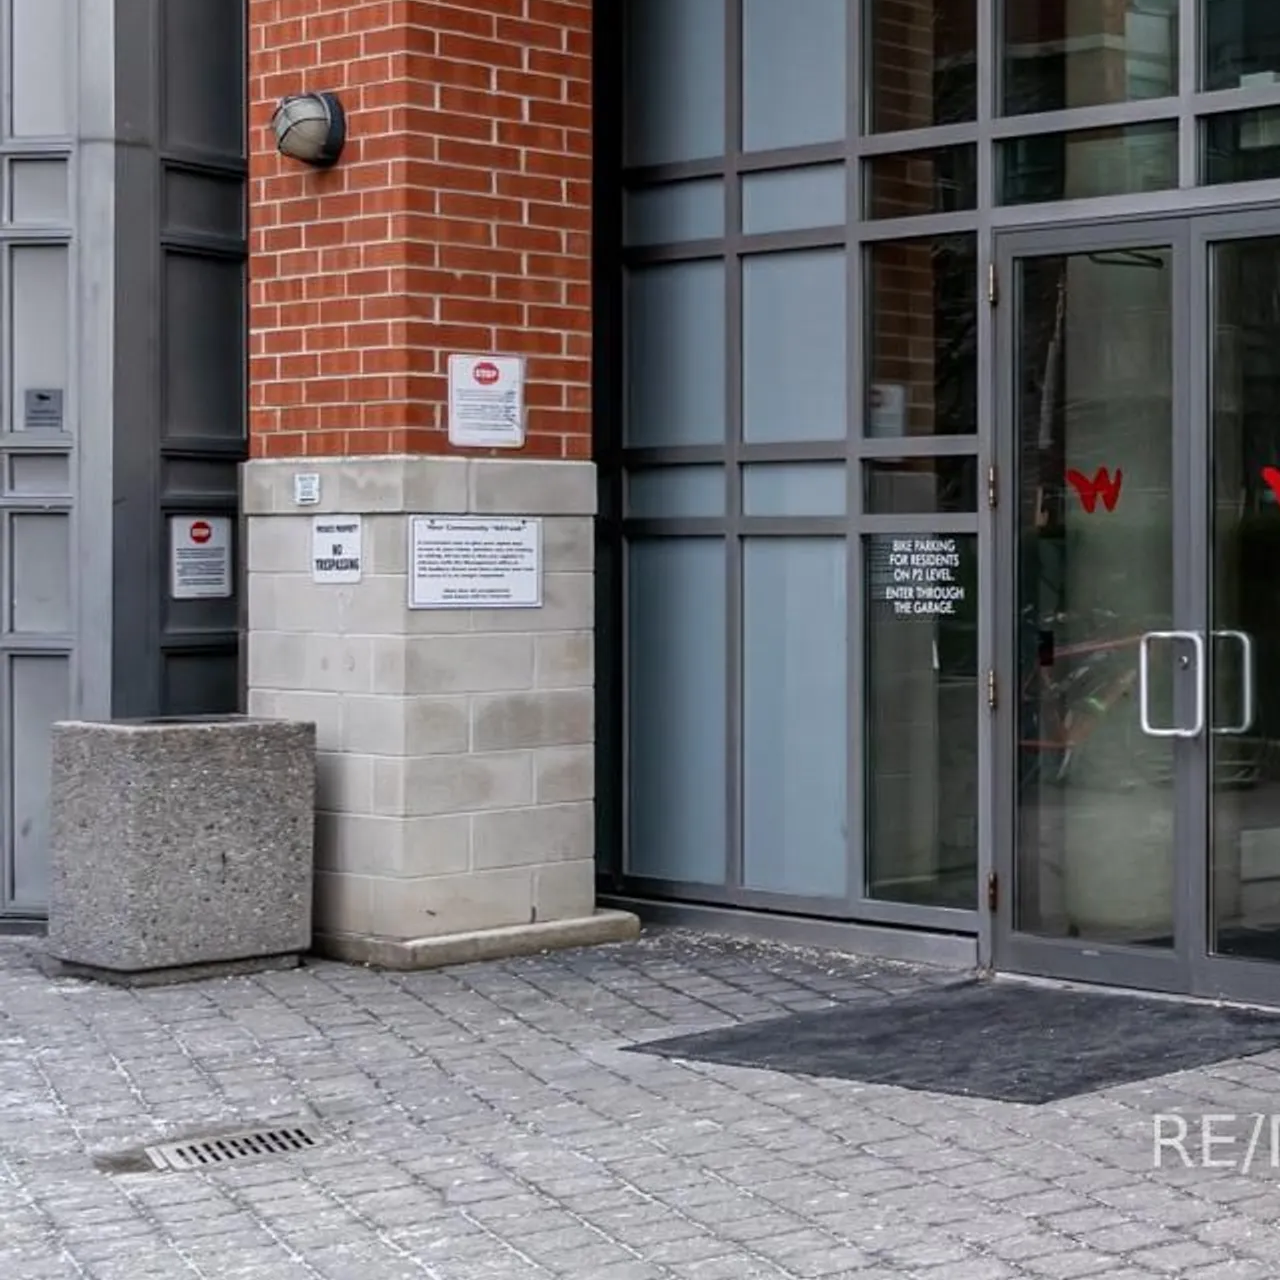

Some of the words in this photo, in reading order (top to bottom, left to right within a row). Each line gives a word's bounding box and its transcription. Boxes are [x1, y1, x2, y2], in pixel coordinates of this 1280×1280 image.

[475, 369, 498, 378] STOP
[332, 543, 343, 556] NO
[892, 539, 912, 552] BIKE
[914, 539, 956, 552] PARKING
[315, 558, 360, 571] TRESPASSING
[889, 553, 908, 566] FOR
[910, 553, 960, 567] RESIDENTS
[894, 567, 910, 581] ON
[912, 567, 924, 581] P2
[926, 568, 956, 581] LEVEL.
[885, 586, 914, 600] ENTER
[915, 586, 965, 600] THROUGH
[894, 601, 912, 614] THE
[914, 601, 956, 614] GARAGE.
